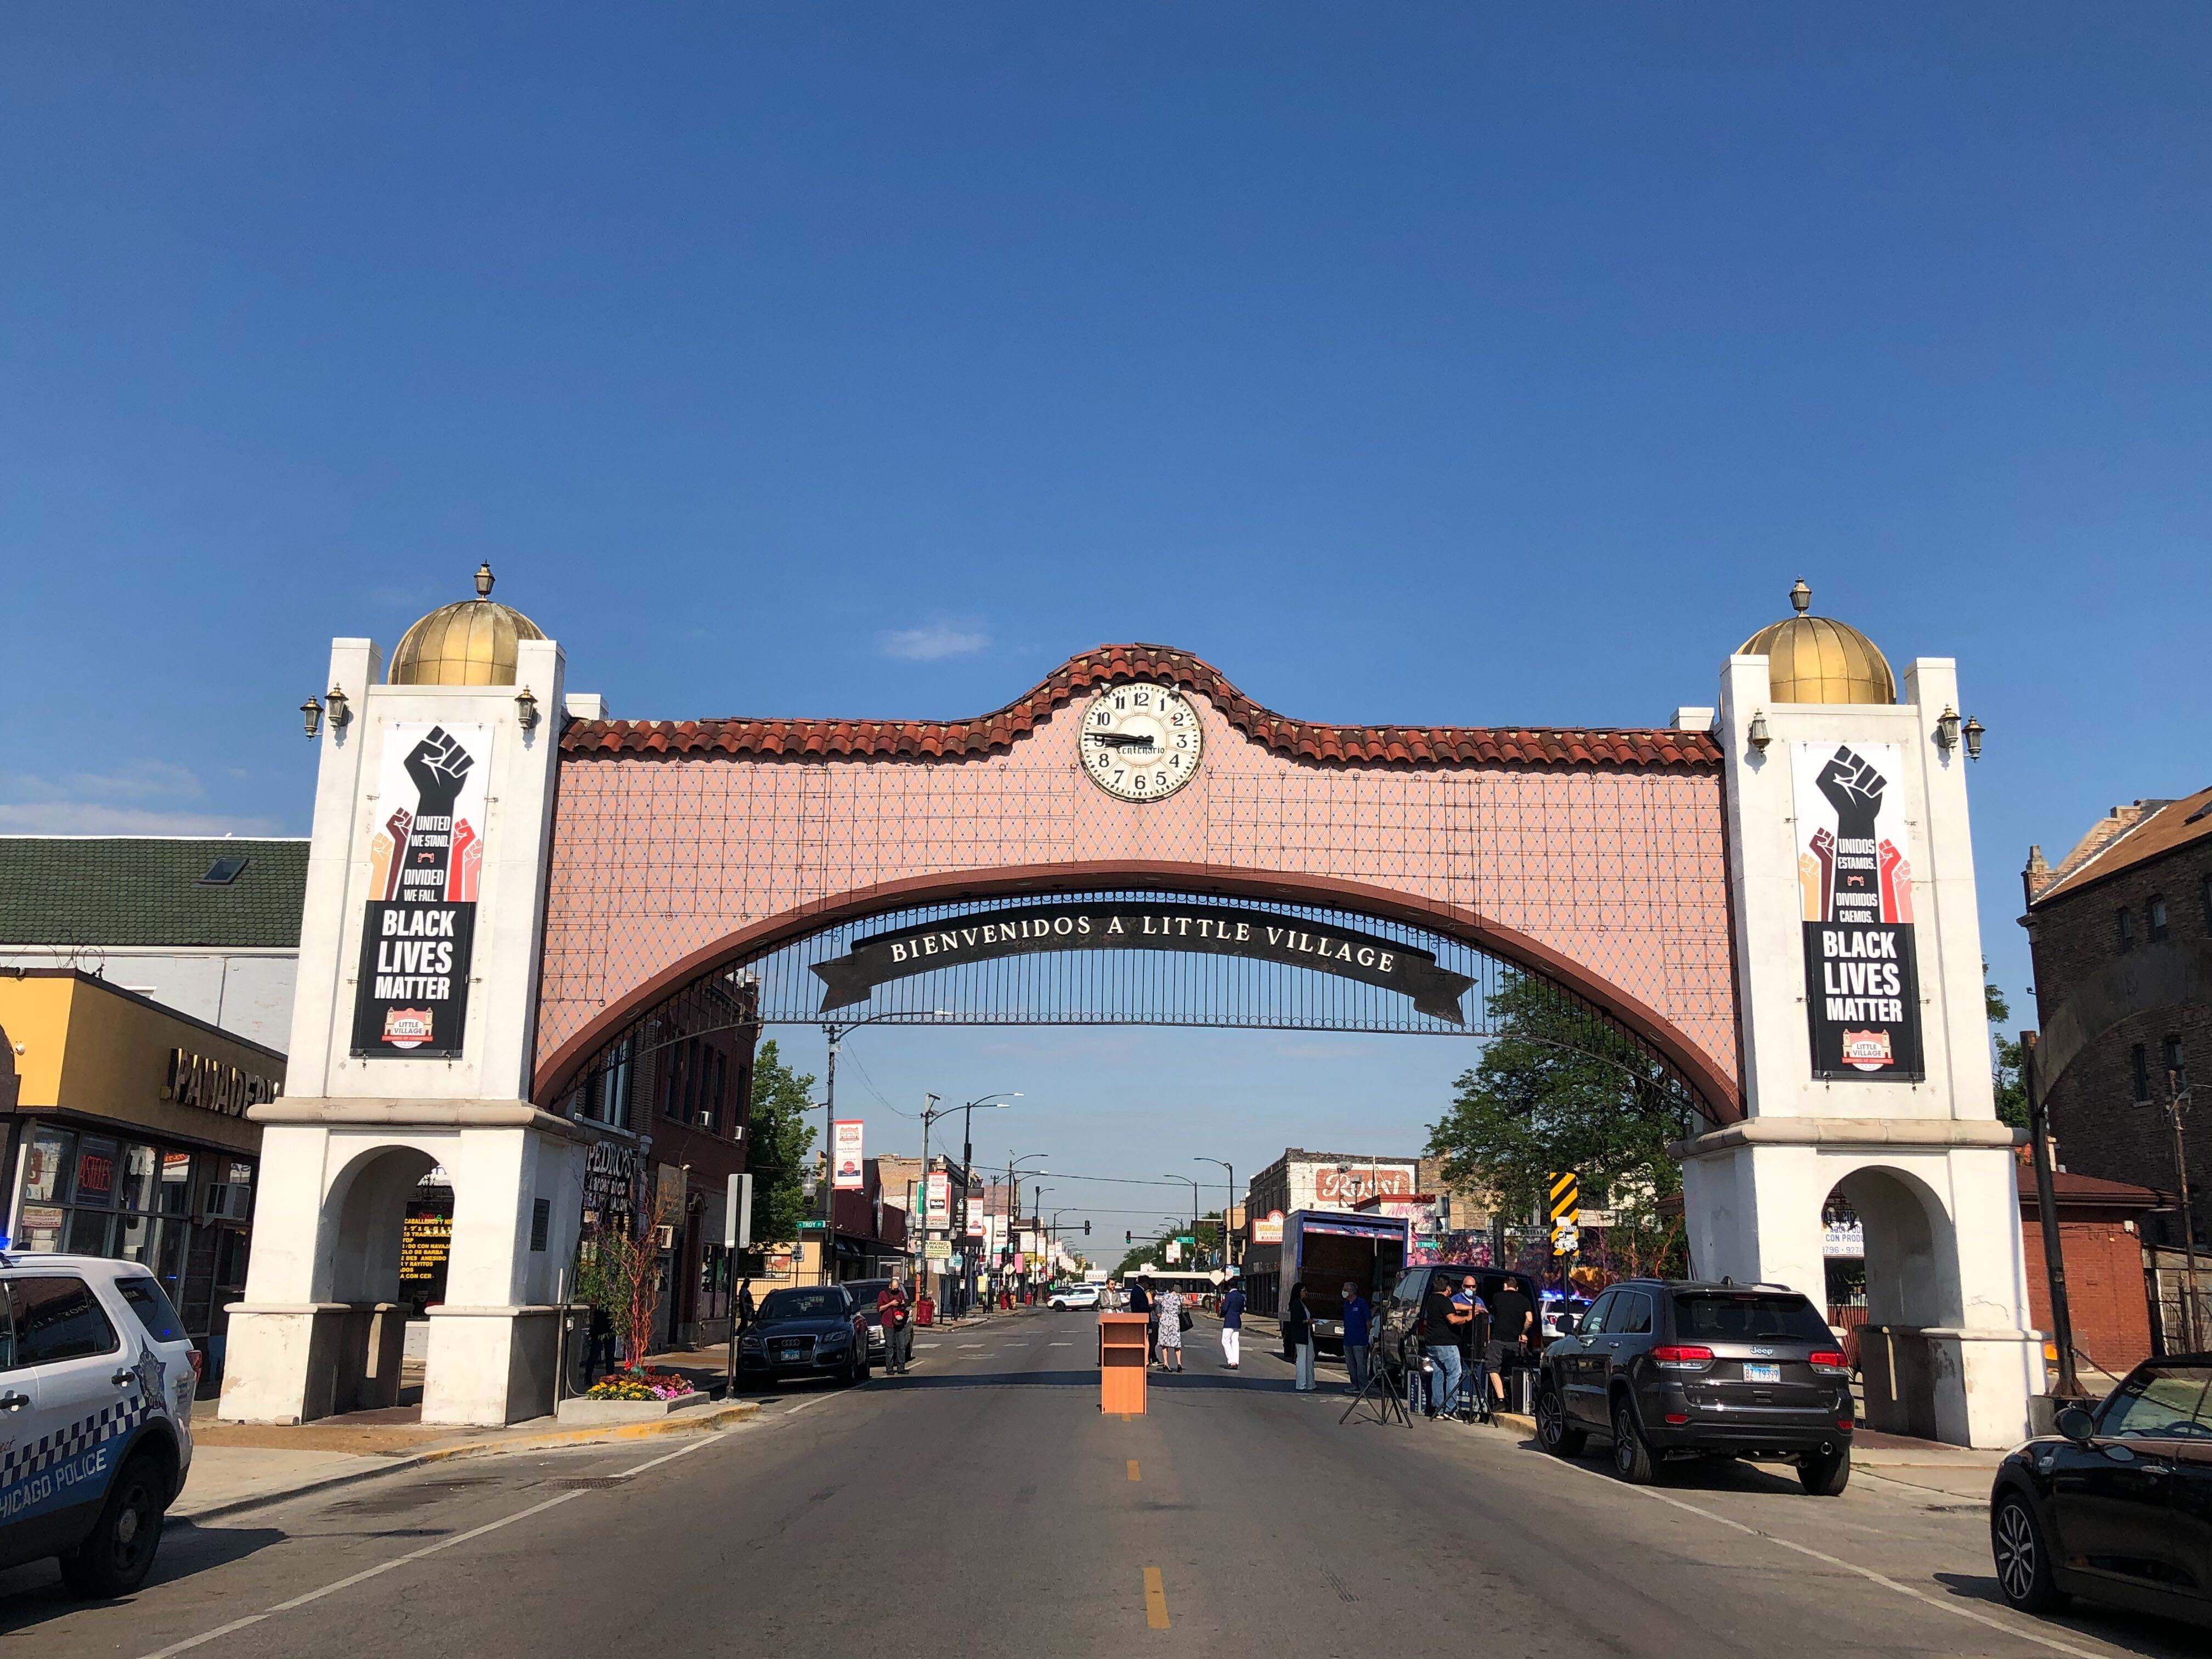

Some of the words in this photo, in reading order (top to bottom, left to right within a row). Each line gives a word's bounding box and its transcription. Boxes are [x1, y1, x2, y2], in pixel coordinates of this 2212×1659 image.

[1115, 696, 1125, 709] 11
[1133, 692, 1149, 707] 12
[1160, 698, 1165, 712] 1
[1097, 712, 1110, 726] 10
[1173, 713, 1184, 726] 2
[1176, 734, 1187, 748] 3
[1116, 746, 1165, 755] Centenario
[1098, 753, 1109, 768] 8
[1169, 754, 1179, 768] 4
[1114, 770, 1125, 784] 7
[1135, 775, 1146, 789] 6
[1156, 771, 1167, 785] 5
[416, 815, 451, 831] UNITED
[411, 834, 424, 847] WE
[424, 834, 449, 847] STAND.
[1838, 838, 1875, 854] UNIDOS
[1837, 857, 1876, 870] ESTAMOS.
[404, 869, 444, 885] DIVIDED
[404, 889, 419, 901] WE
[418, 889, 438, 902] FALL.
[1836, 892, 1877, 906] DIVIDIDOS
[382, 910, 456, 936] BLACK
[1839, 910, 1874, 923] CAEMOS.
[891, 916, 1092, 962] BIENVENIDOS
[1107, 916, 1124, 934] A
[1143, 916, 1250, 941] LITTLE
[1266, 927, 1395, 973] VILLAGE
[1822, 930, 1897, 958] BLACK
[377, 941, 453, 974] LIVES
[1824, 962, 1900, 996] LIVES
[374, 976, 450, 1000] MATTER
[1826, 998, 1903, 1022] MATTER
[1322, 1173, 1401, 1198] Rossi
[1750, 1346, 1773, 1356] Jeep
[1746, 1368, 1753, 1378] BZ
[55, 1447, 107, 1492] POLICE
